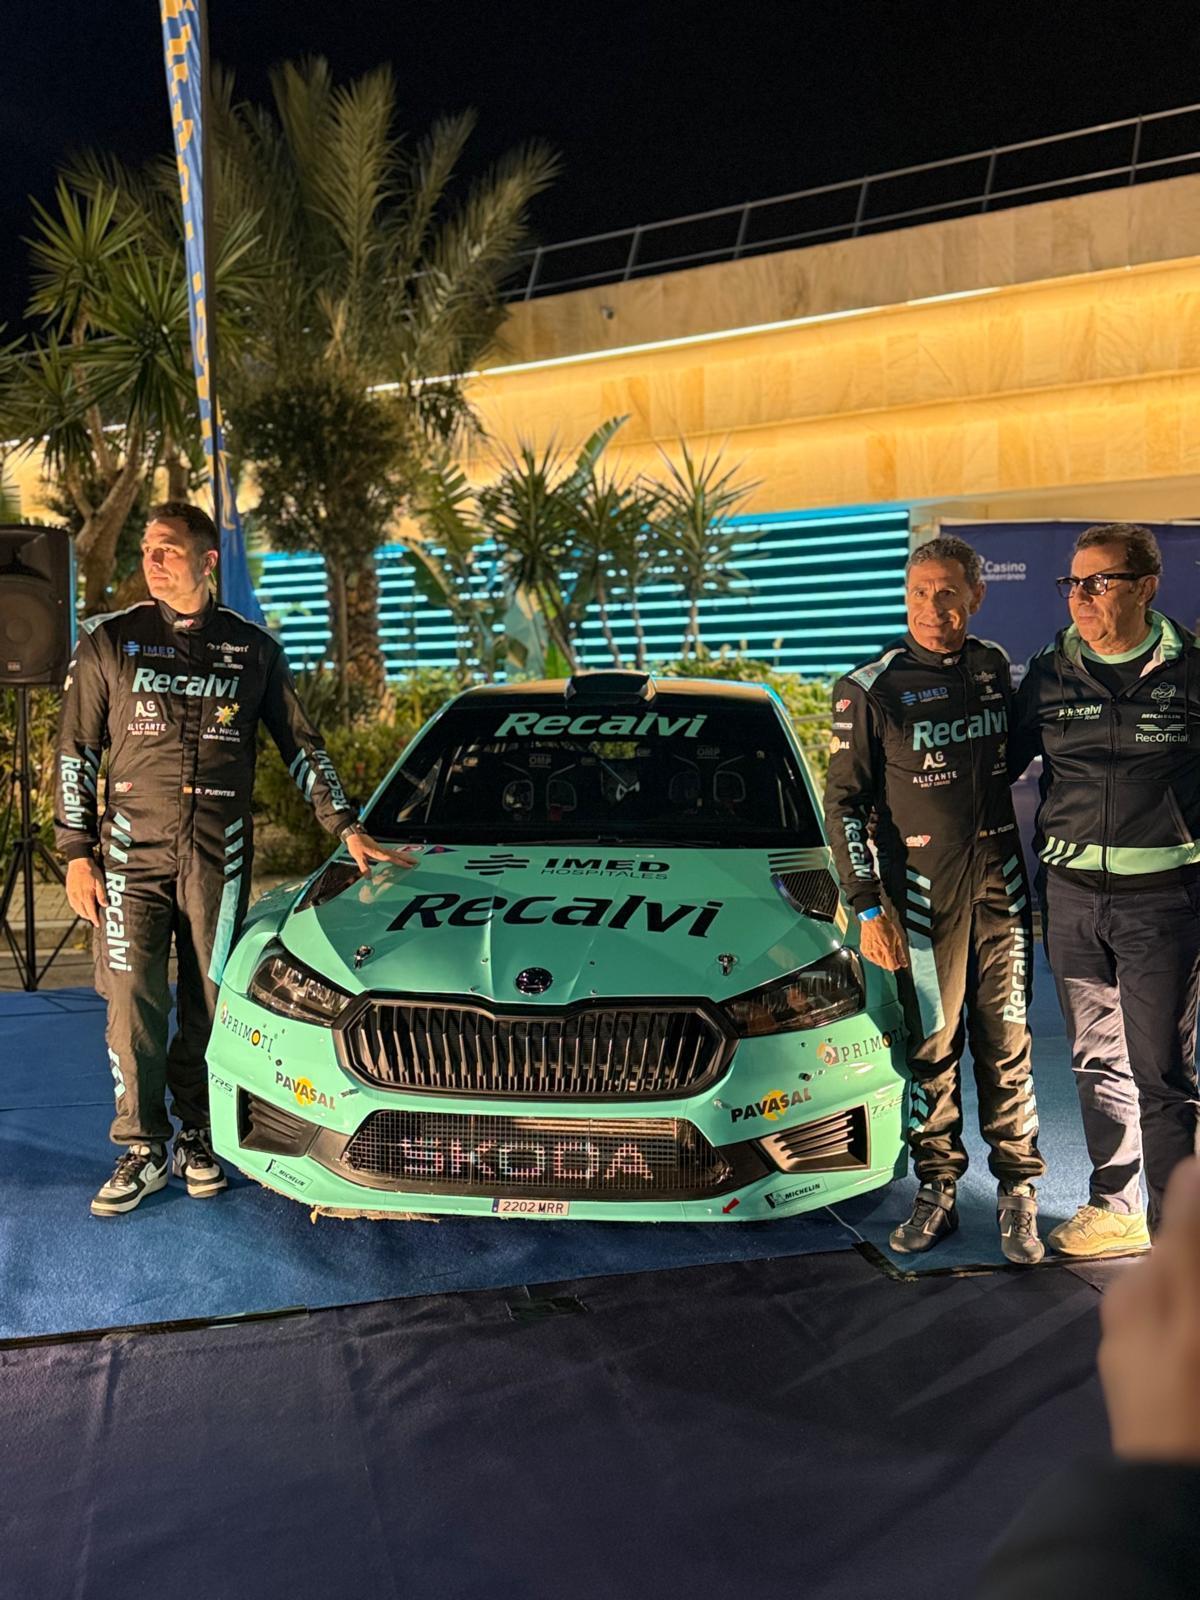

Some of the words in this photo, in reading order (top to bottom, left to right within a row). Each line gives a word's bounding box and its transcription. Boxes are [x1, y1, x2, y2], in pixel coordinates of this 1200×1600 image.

[984, 560, 1026, 573] Casino
[143, 645, 175, 654] IMED
[132, 667, 240, 699] Recalvi
[918, 687, 947, 699] IMED
[127, 723, 167, 732] ALICANTE
[494, 712, 707, 738] Recalvi
[912, 707, 1008, 751] Recalvi
[1135, 733, 1188, 743] RecOficial
[312, 750, 351, 811] Recalvi
[912, 770, 958, 784] ALICANTE
[61, 755, 87, 830] Recalvi
[541, 868, 668, 880] HOSPITALES
[544, 858, 670, 873] IMED
[105, 871, 132, 972] Recalvi
[386, 893, 723, 938] Recalvi
[1002, 927, 1030, 1025] Recalvi
[226, 1010, 274, 1053] PRIMOTI
[841, 1028, 906, 1062] PRIMOTI
[275, 1071, 337, 1111] PAVASAL
[731, 1087, 812, 1124] PAVASAL
[279, 1169, 307, 1187] MICHELIN
[785, 1182, 821, 1200] MICHELIN
[502, 1201, 535, 1213] 2202
[537, 1202, 564, 1214] MRR
